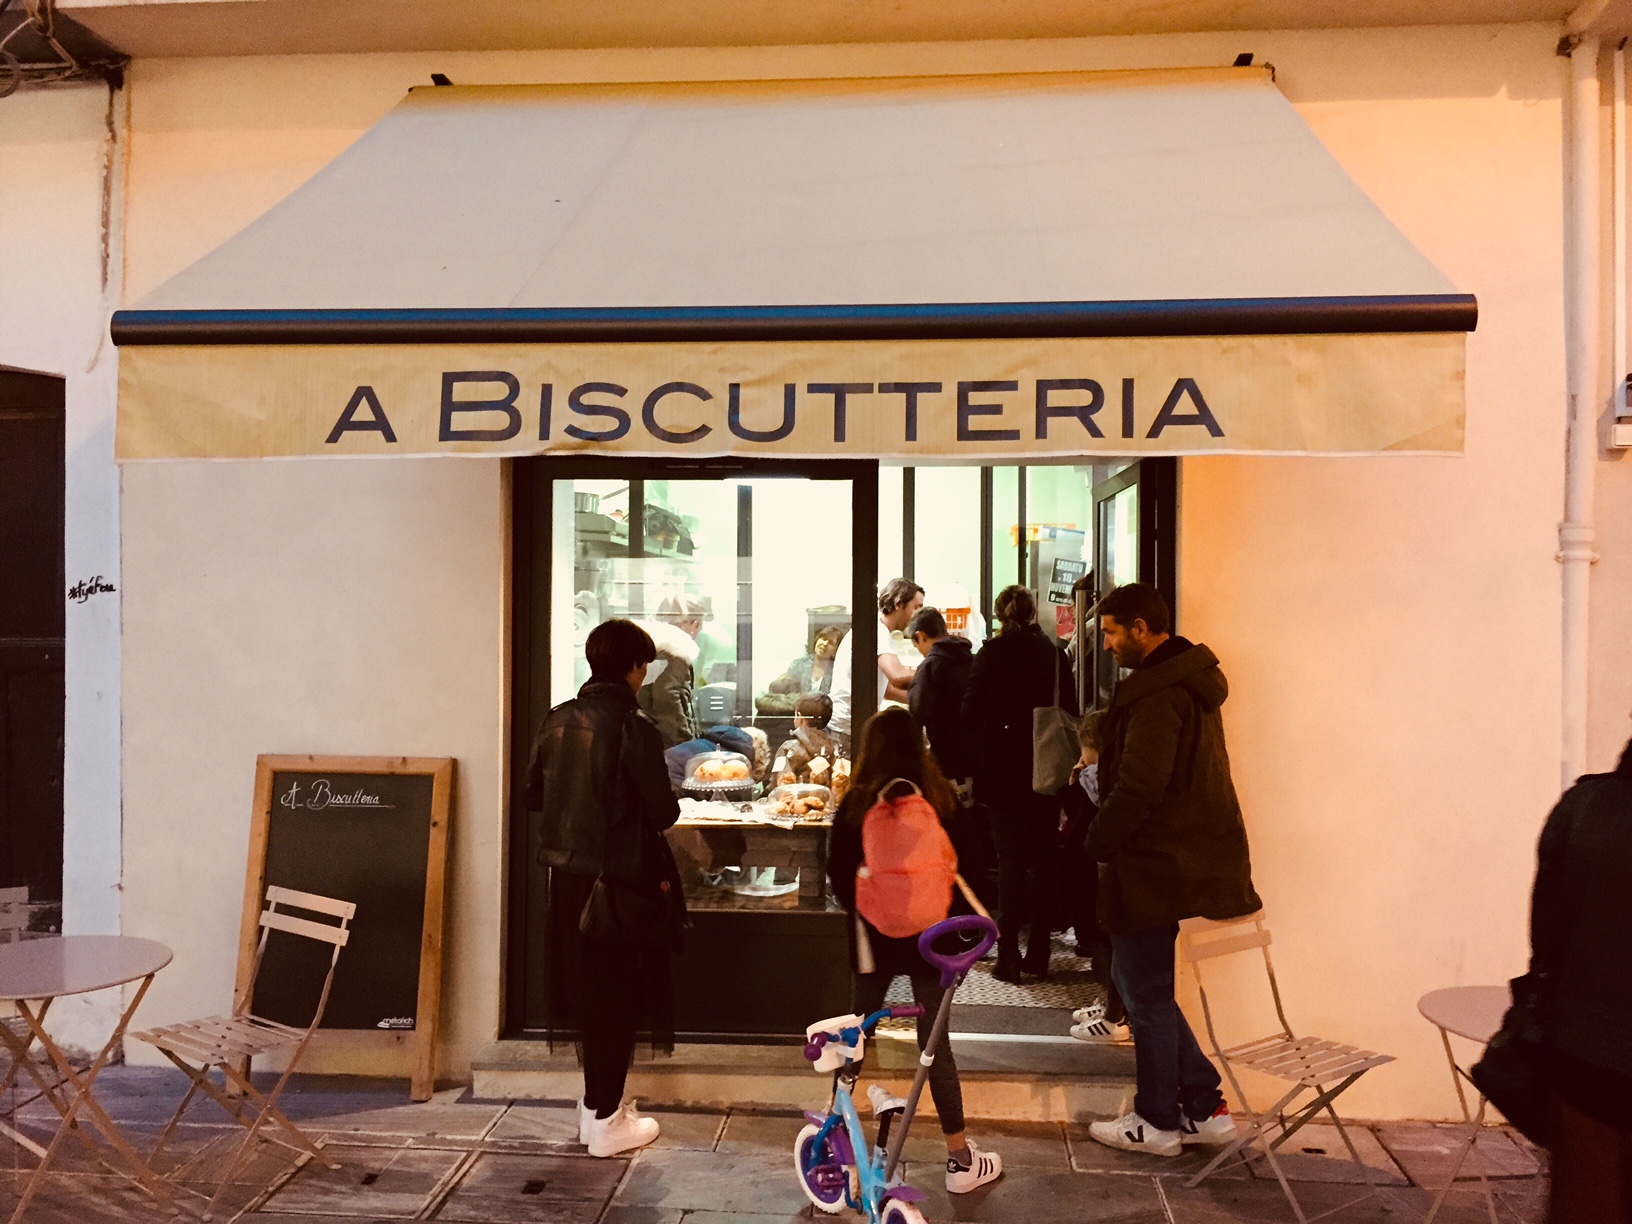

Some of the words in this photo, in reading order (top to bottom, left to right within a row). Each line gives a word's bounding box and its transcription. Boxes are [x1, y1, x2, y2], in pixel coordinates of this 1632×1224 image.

[324, 385, 398, 444] A
[438, 370, 1226, 444] BISCUTTERIA
[1062, 573, 1072, 583] 18
[280, 781, 302, 810] A
